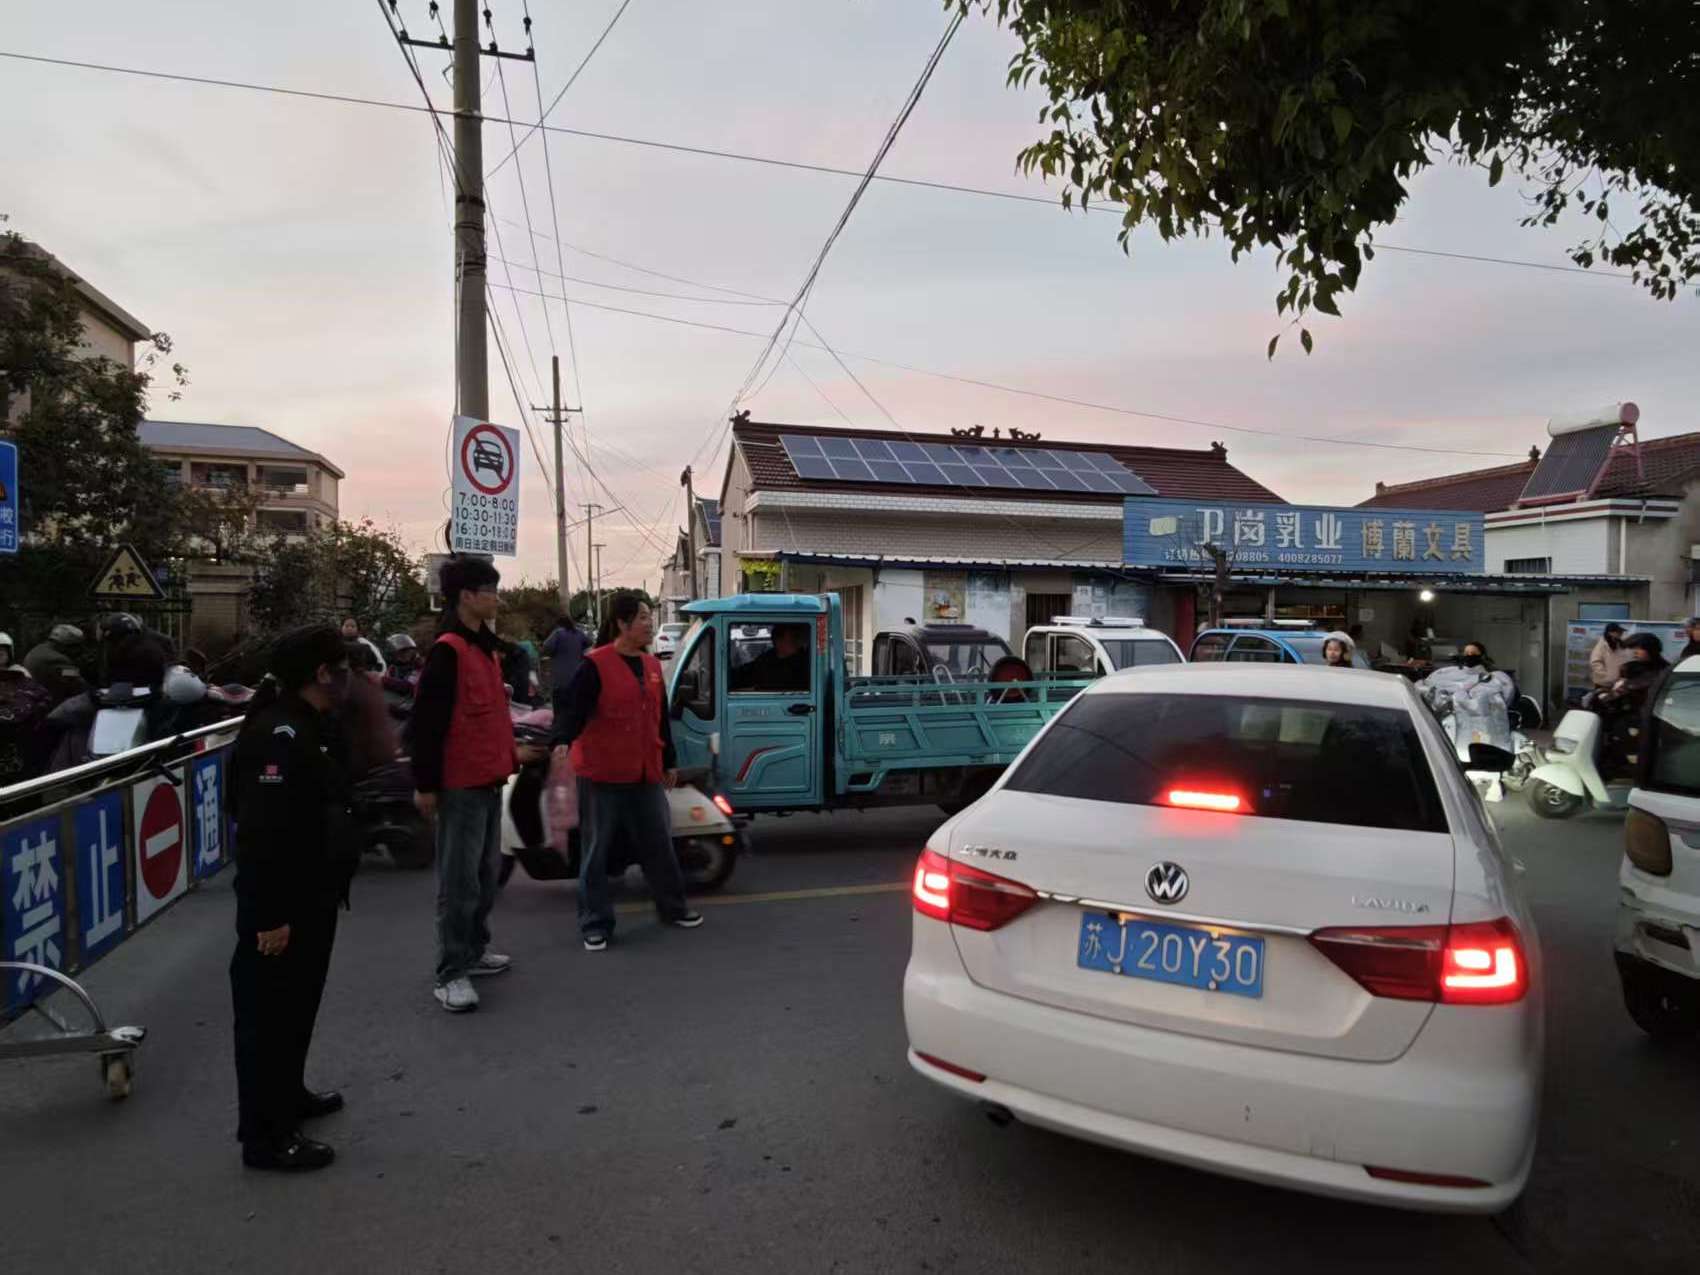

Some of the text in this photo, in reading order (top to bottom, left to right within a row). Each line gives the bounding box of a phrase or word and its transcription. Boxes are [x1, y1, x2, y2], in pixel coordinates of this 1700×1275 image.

[459, 491, 515, 511] 7:00-8:00
[456, 506, 516, 526] 10:30-11:30
[1194, 508, 1343, 549] 卫岗乳业
